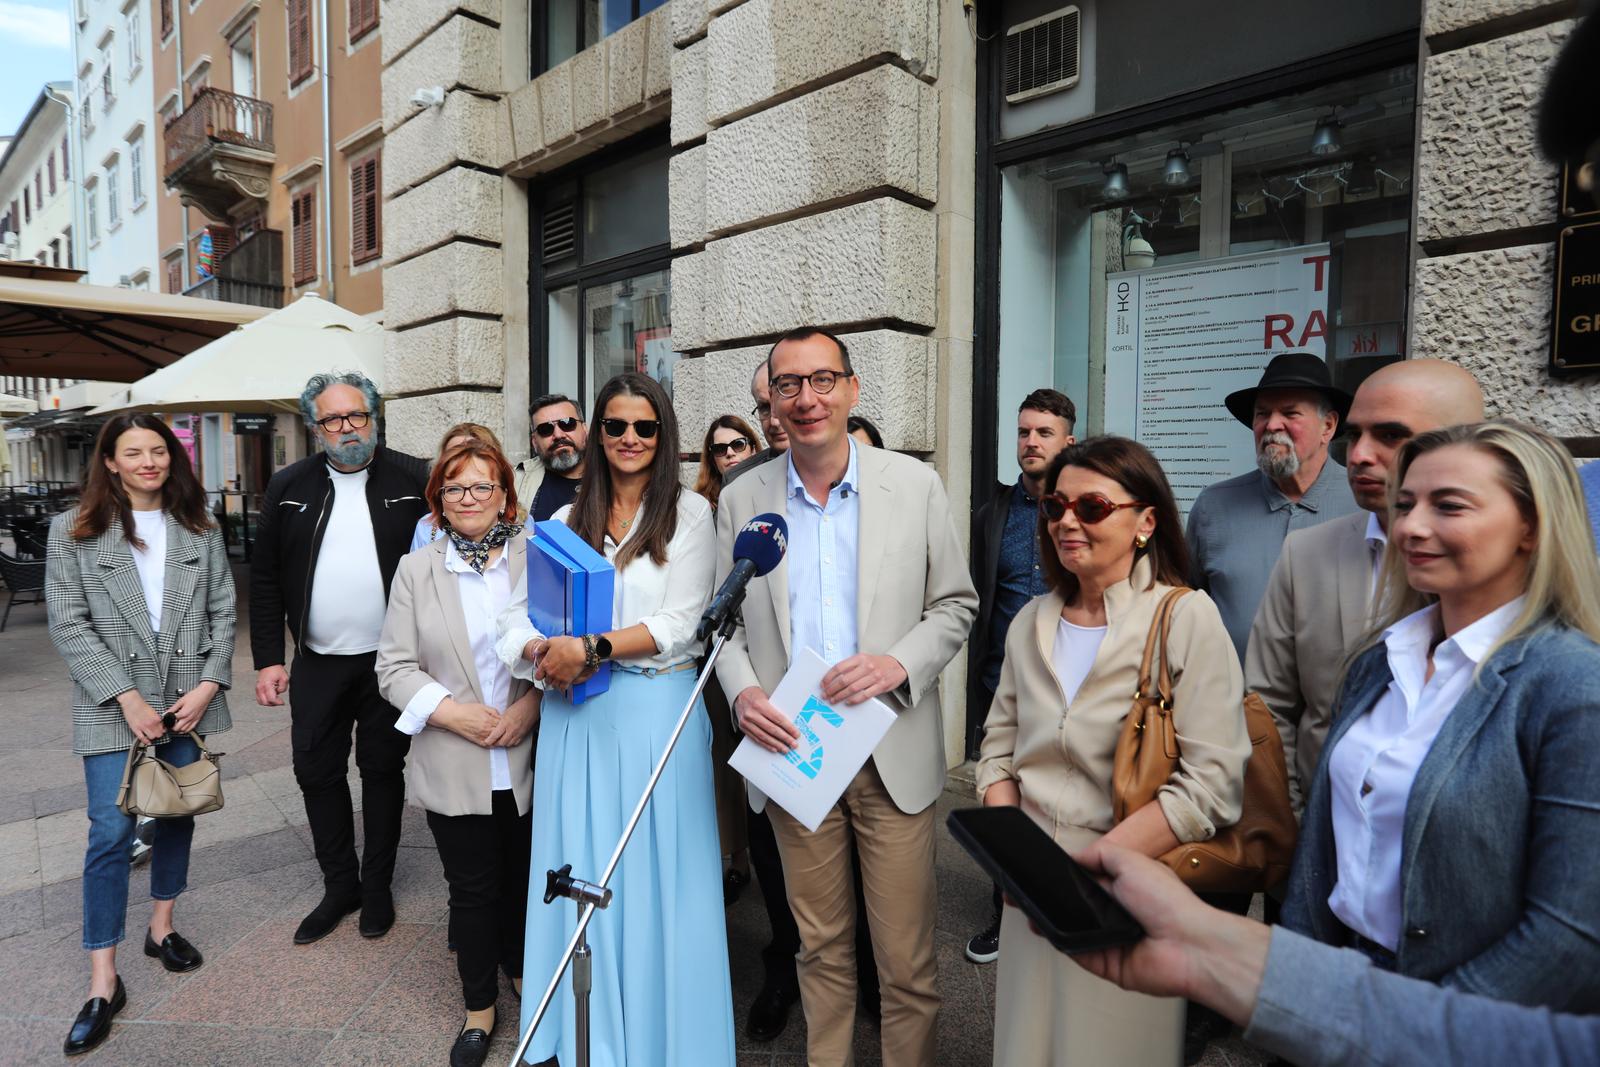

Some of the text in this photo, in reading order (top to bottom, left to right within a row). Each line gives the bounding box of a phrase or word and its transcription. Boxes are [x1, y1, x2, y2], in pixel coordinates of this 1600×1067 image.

[1303, 255, 1332, 292] T
[1264, 310, 1328, 349] RA
[1570, 313, 1600, 333] G
